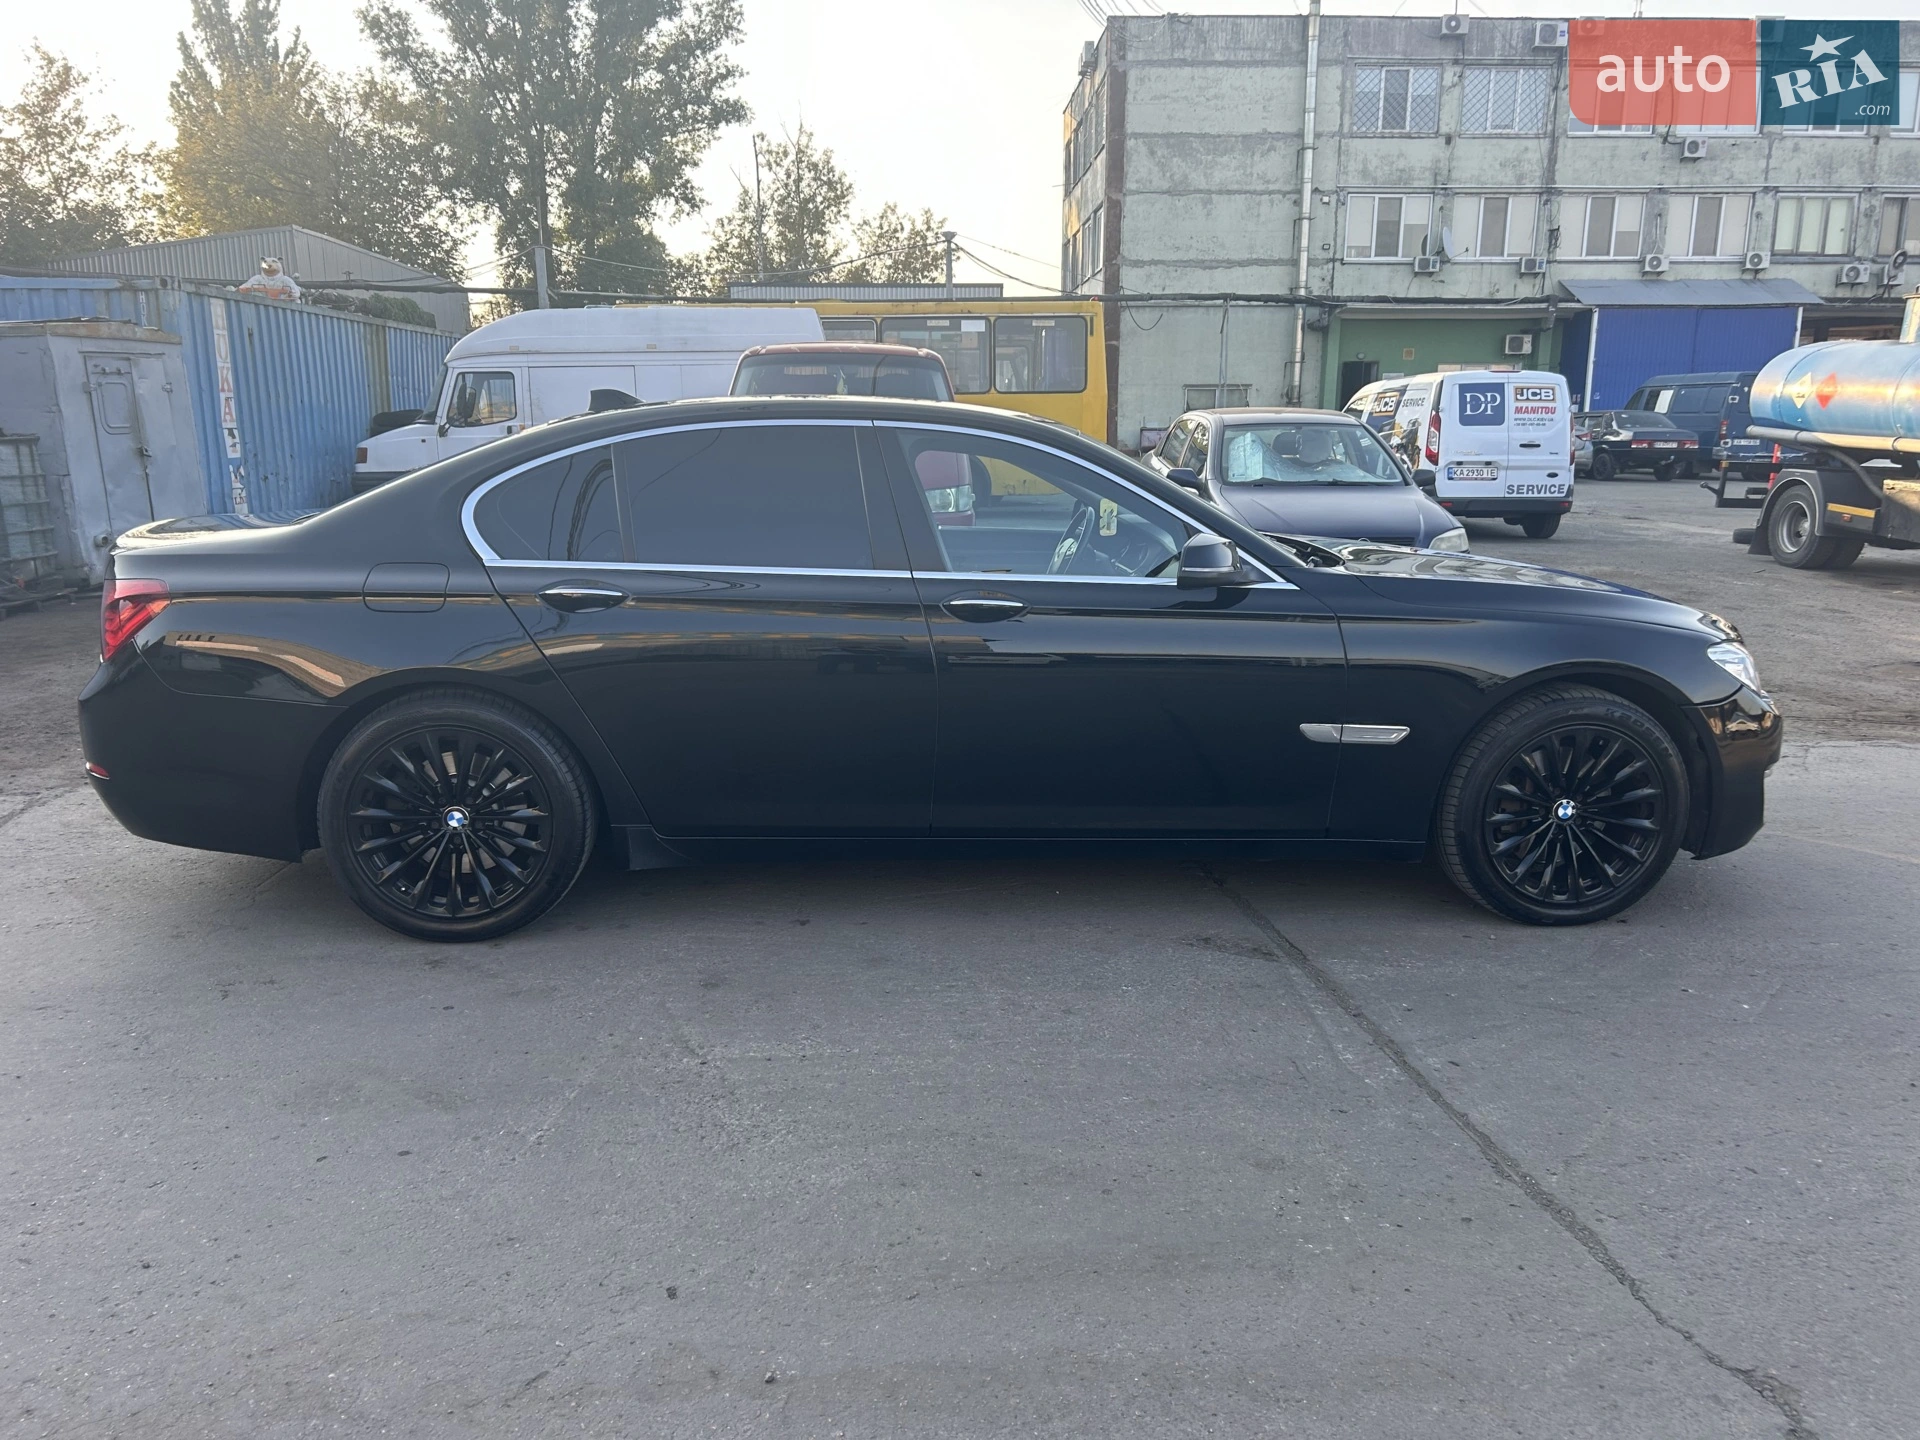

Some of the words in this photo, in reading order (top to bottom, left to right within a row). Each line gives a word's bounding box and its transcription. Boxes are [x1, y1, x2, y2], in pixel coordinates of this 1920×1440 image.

[1516, 388, 1554, 401] JCB
[1374, 397, 1396, 413] JCB
[1402, 397, 1426, 408] SERVICE
[1464, 392, 1501, 415] DP
[1514, 406, 1557, 415] MANITOU
[1453, 469, 1465, 477] KA
[1465, 469, 1484, 477] 2930
[1486, 469, 1496, 477] IE
[1506, 484, 1566, 495] SERVICE
